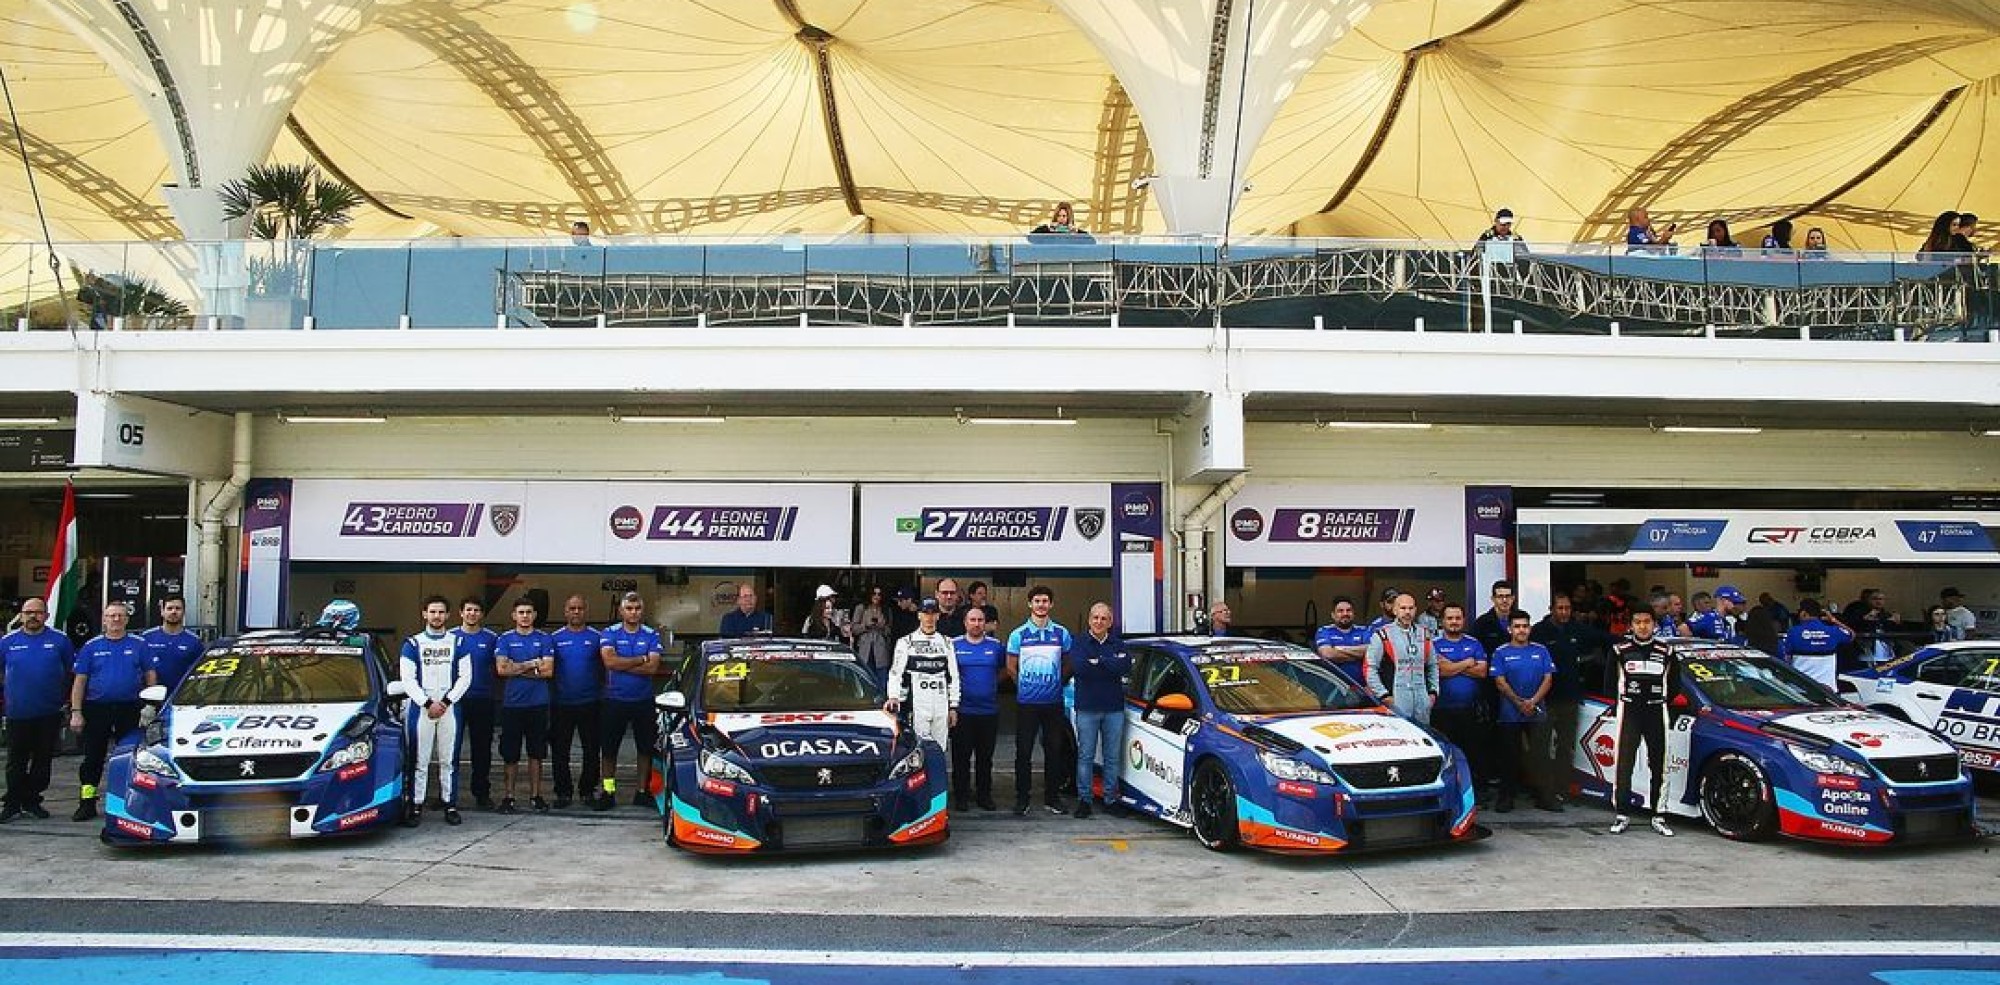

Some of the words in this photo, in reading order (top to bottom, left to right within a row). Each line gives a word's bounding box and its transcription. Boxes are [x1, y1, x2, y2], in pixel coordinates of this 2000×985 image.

[120, 423, 144, 445] 05
[344, 506, 385, 532] 43
[386, 507, 438, 519] PEDRO
[711, 511, 770, 524] LEONEL
[968, 511, 1037, 524] MARCOS
[1325, 513, 1382, 525] RAFAEL
[383, 521, 454, 533] CARDOSO
[659, 511, 704, 536] 44
[923, 511, 968, 538] 27
[1297, 512, 1321, 538] 8
[708, 526, 765, 538] PERNIA
[966, 525, 1041, 538] REGADAS
[1321, 526, 1379, 538] SUZUKI
[1650, 529, 1669, 541] 07
[1810, 527, 1877, 538] COBRA
[1918, 530, 1936, 543] 47
[196, 658, 240, 674] 43
[708, 662, 750, 678] 44
[1688, 662, 1713, 681] 8
[1200, 665, 1240, 684] 27
[237, 714, 319, 730] BRB
[1677, 718, 1691, 732] 8
[1935, 718, 1966, 736] DO
[225, 736, 303, 749] Cifarma
[760, 739, 853, 758] OCASA
[1823, 803, 1869, 815] Online
